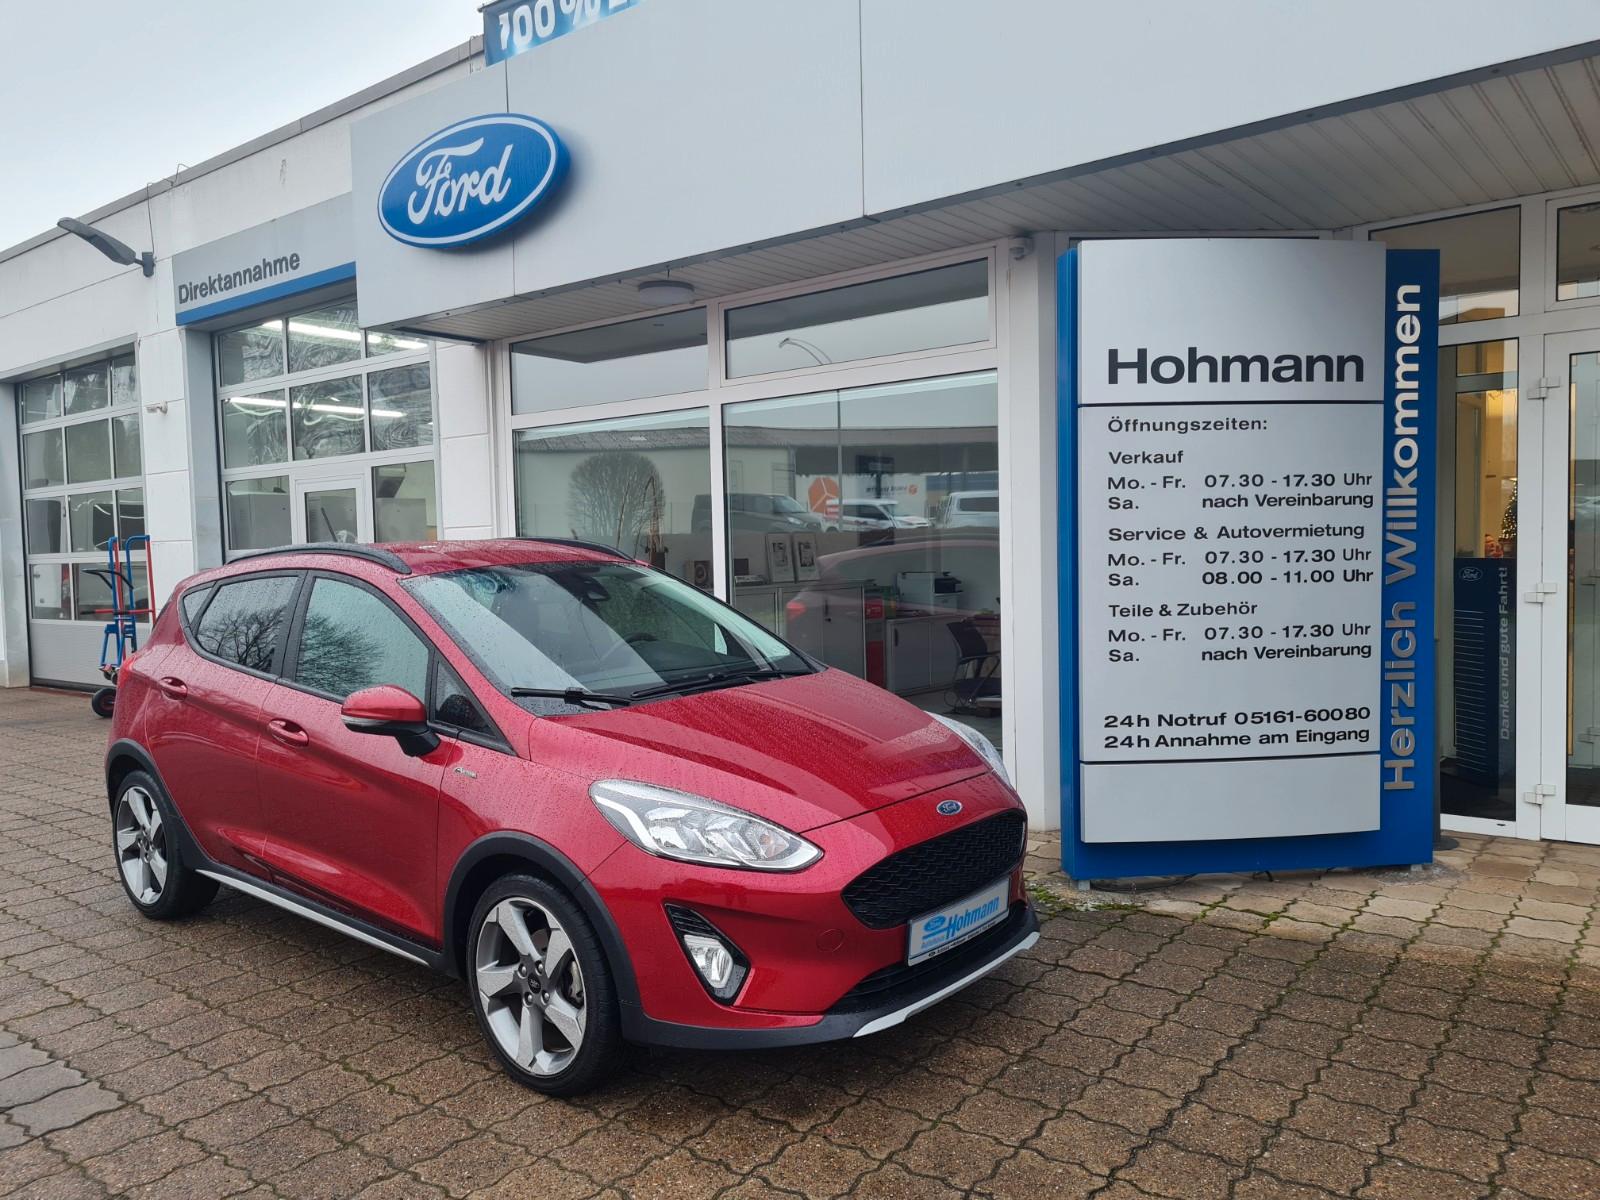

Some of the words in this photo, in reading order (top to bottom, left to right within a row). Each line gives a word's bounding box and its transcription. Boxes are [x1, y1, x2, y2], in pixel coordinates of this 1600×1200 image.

[407, 136, 514, 225] Ford
[178, 252, 301, 305] Direktannahme
[1108, 346, 1365, 385] Hohmann
[1107, 415, 1268, 435] Öffnungszeiten:
[1384, 283, 1422, 586] Willkommen
[1108, 449, 1184, 465] Verkauf
[1107, 476, 1145, 490] Mo.
[1162, 475, 1186, 489] Fr.
[1204, 473, 1264, 488] 07.30
[1282, 473, 1336, 488] 17.30
[1343, 472, 1373, 486] Uhr
[1108, 496, 1139, 510] Sa.
[1202, 494, 1249, 509] nach
[1254, 492, 1374, 509] Vereinbarung
[1108, 527, 1186, 542] Service
[1193, 526, 1209, 540] &
[1216, 523, 1365, 540] Autovermietung
[1107, 553, 1145, 567] Mo.
[1162, 552, 1186, 566] Fr.
[1204, 550, 1264, 565] 07.30
[1283, 548, 1336, 564] 17.30
[1342, 547, 1372, 562] Uhr
[1108, 573, 1139, 587] Sa.
[1201, 571, 1263, 585] 08.00
[1283, 569, 1335, 584] 11.00
[1343, 568, 1374, 583] Uhr
[1498, 567, 1508, 614] Fahrt!
[1108, 604, 1154, 618] Teile
[1158, 603, 1172, 617] &
[1176, 601, 1258, 617] Zubehör
[1108, 629, 1146, 643] Mo.
[1162, 628, 1186, 641] Fr.
[1204, 625, 1264, 641] 07.30
[1282, 623, 1335, 639] 17.30
[1342, 623, 1372, 636] Uhr
[1499, 617, 1511, 655] gute
[1108, 648, 1140, 663] Sa.
[1201, 646, 1248, 661] nach
[1253, 644, 1372, 660] Vereinbarung
[1499, 656, 1509, 688] und
[1383, 600, 1417, 791] Herzlich
[1103, 714, 1150, 729] 24h
[1157, 712, 1228, 727] Notruf
[1234, 706, 1371, 726] 05161-60080
[1500, 690, 1510, 740] Danke
[1104, 734, 1150, 749] 24h
[1154, 732, 1252, 748] Annahme
[1258, 733, 1289, 745] am
[1295, 729, 1370, 745] Eingang
[946, 896, 1000, 939] Hohmann
